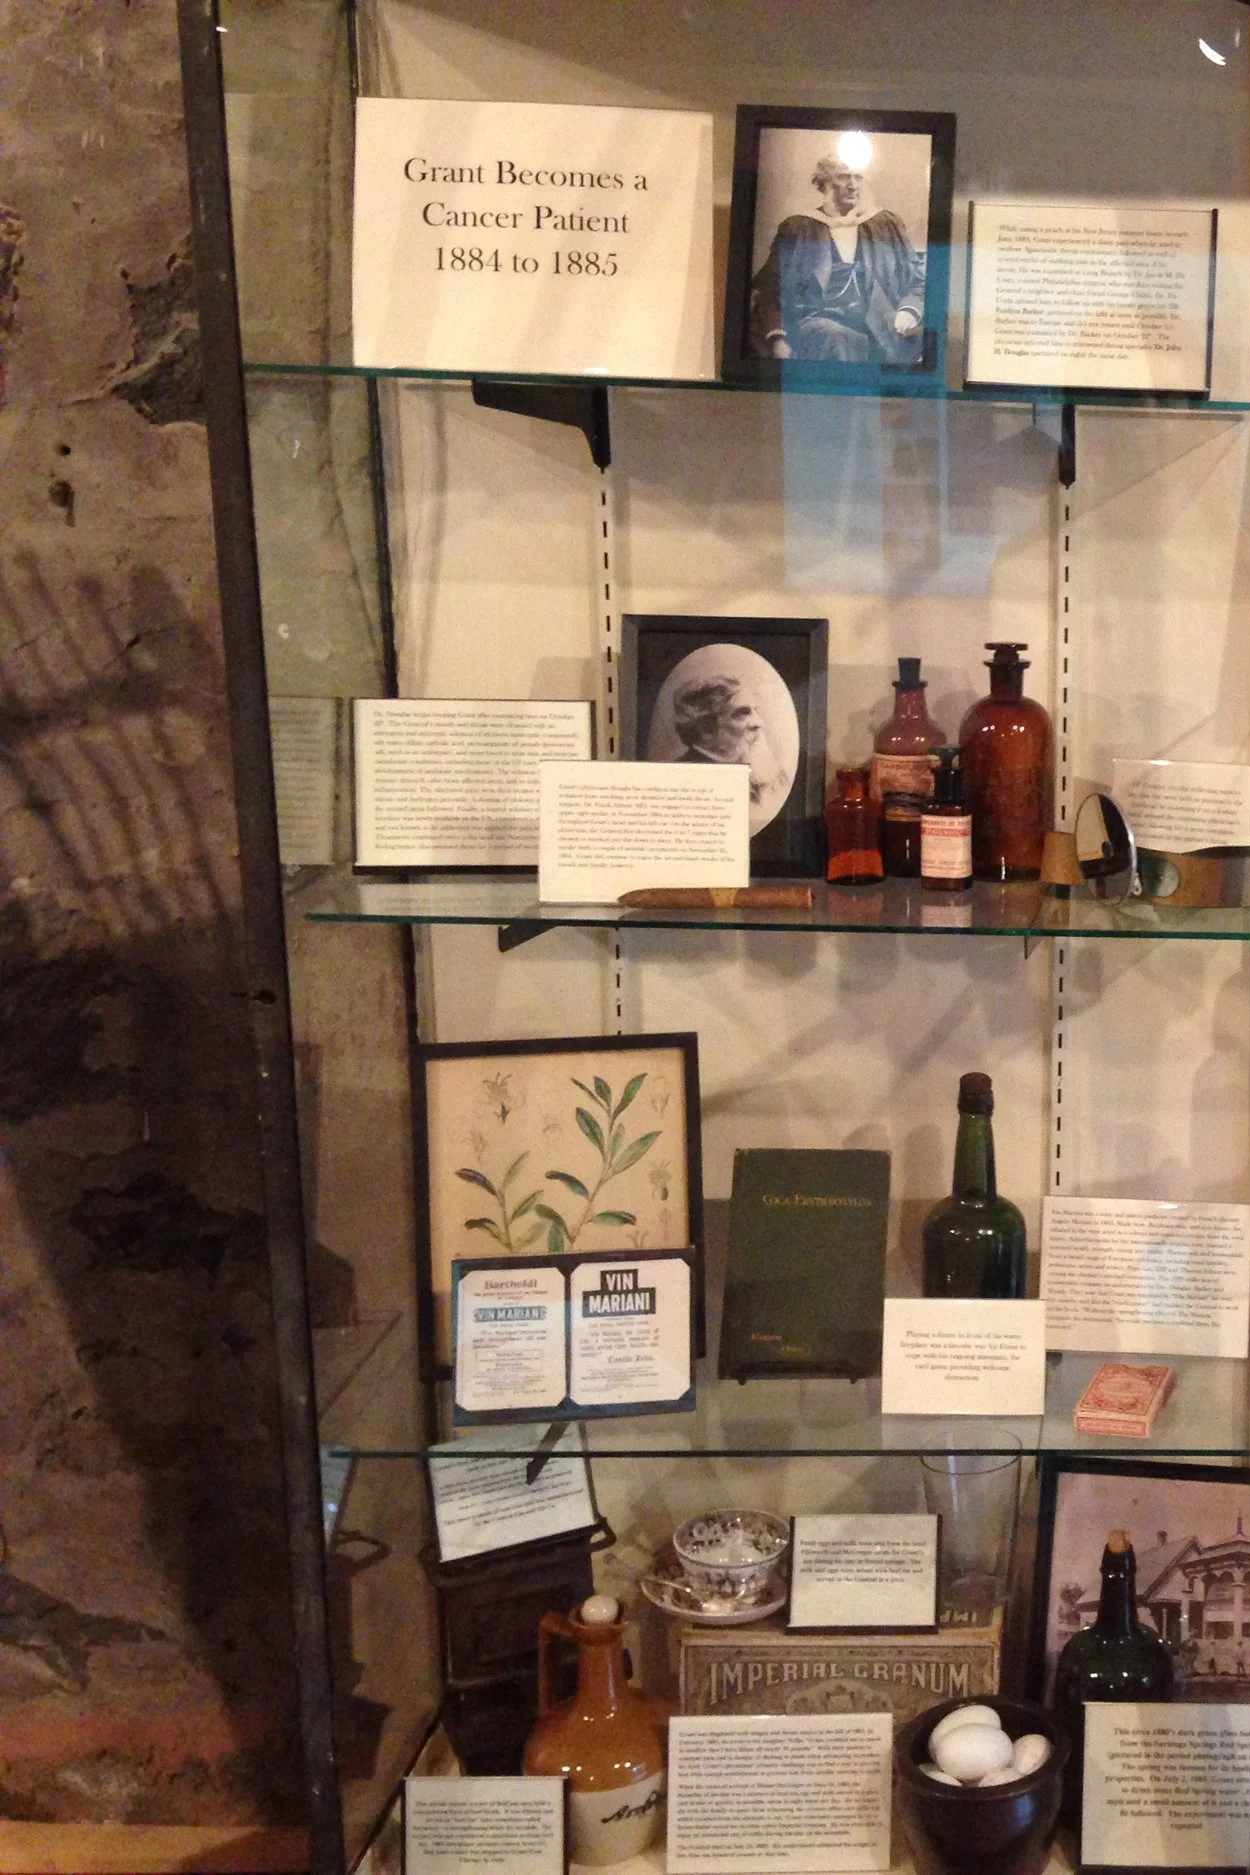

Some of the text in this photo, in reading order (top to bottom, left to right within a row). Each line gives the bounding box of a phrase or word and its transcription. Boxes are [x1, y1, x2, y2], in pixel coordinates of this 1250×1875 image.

[404, 157, 649, 191] Grant Becomes a
[422, 201, 632, 233] Cancer Patient
[436, 246, 619, 277] 1884 to 1885
[484, 1279, 538, 1290] Bartholdi
[606, 1273, 633, 1291] VIN
[477, 1307, 544, 1321] VIN MARIANI
[589, 1292, 650, 1313] MARIANI
[709, 1662, 970, 1705] IMPERIAL GRANUM
